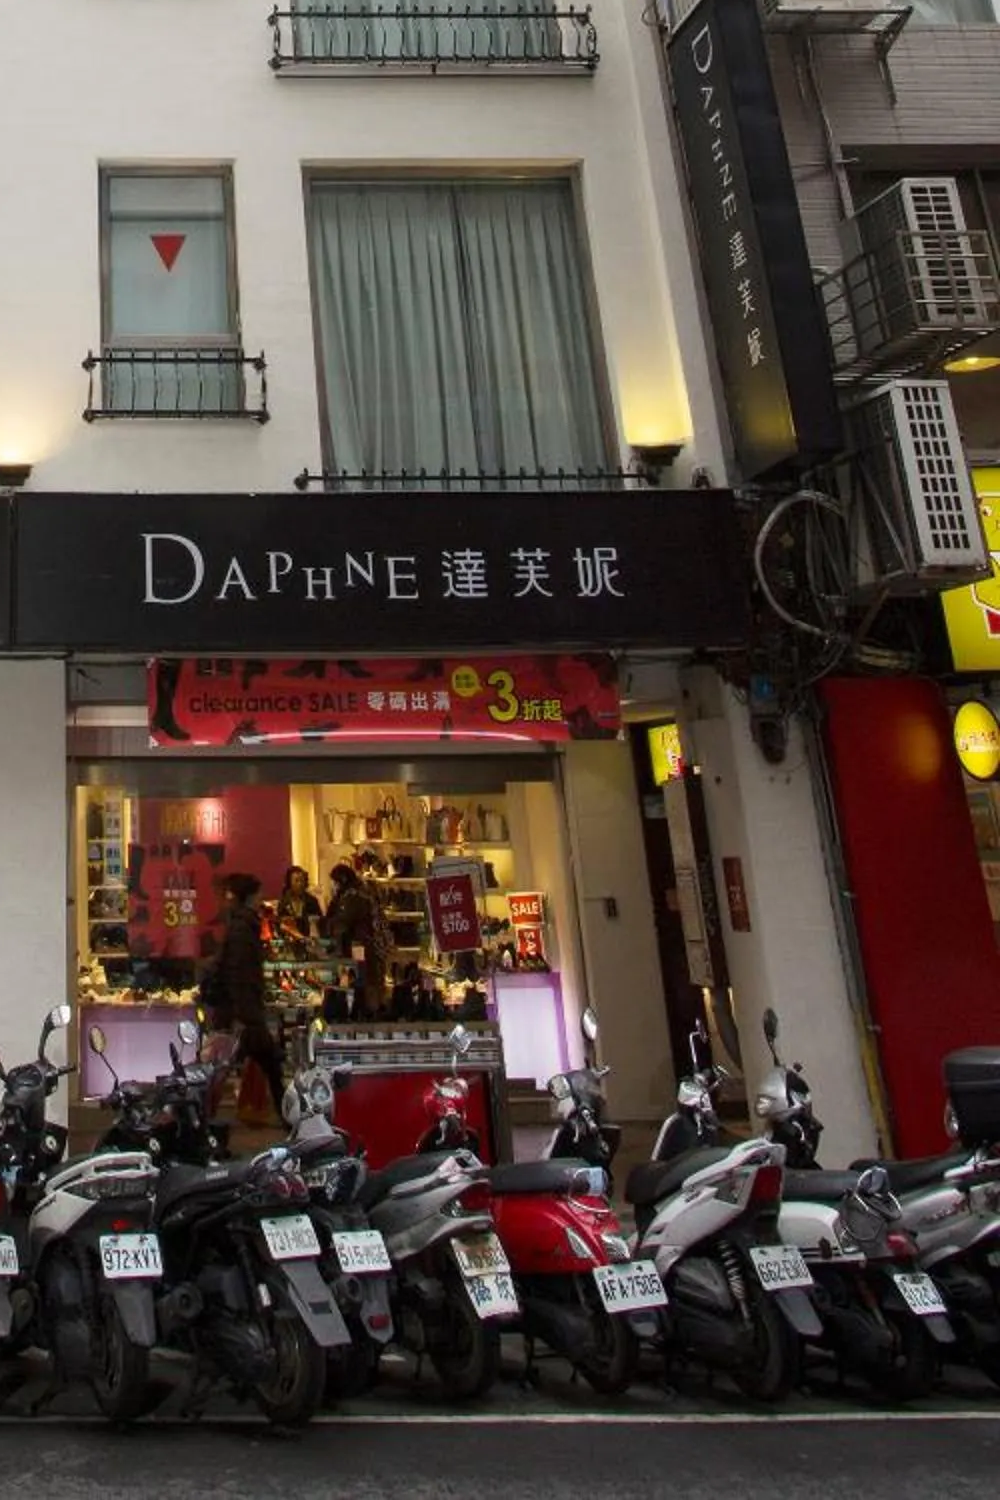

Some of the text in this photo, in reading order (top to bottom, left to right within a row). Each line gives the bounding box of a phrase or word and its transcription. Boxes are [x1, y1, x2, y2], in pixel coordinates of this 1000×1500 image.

[691, 23, 737, 221] DAPHNE
[141, 533, 626, 604] DAPHNE 達芙妮
[189, 692, 302, 713] clearance
[309, 692, 359, 713] SALE
[511, 901, 540, 918] SALE
